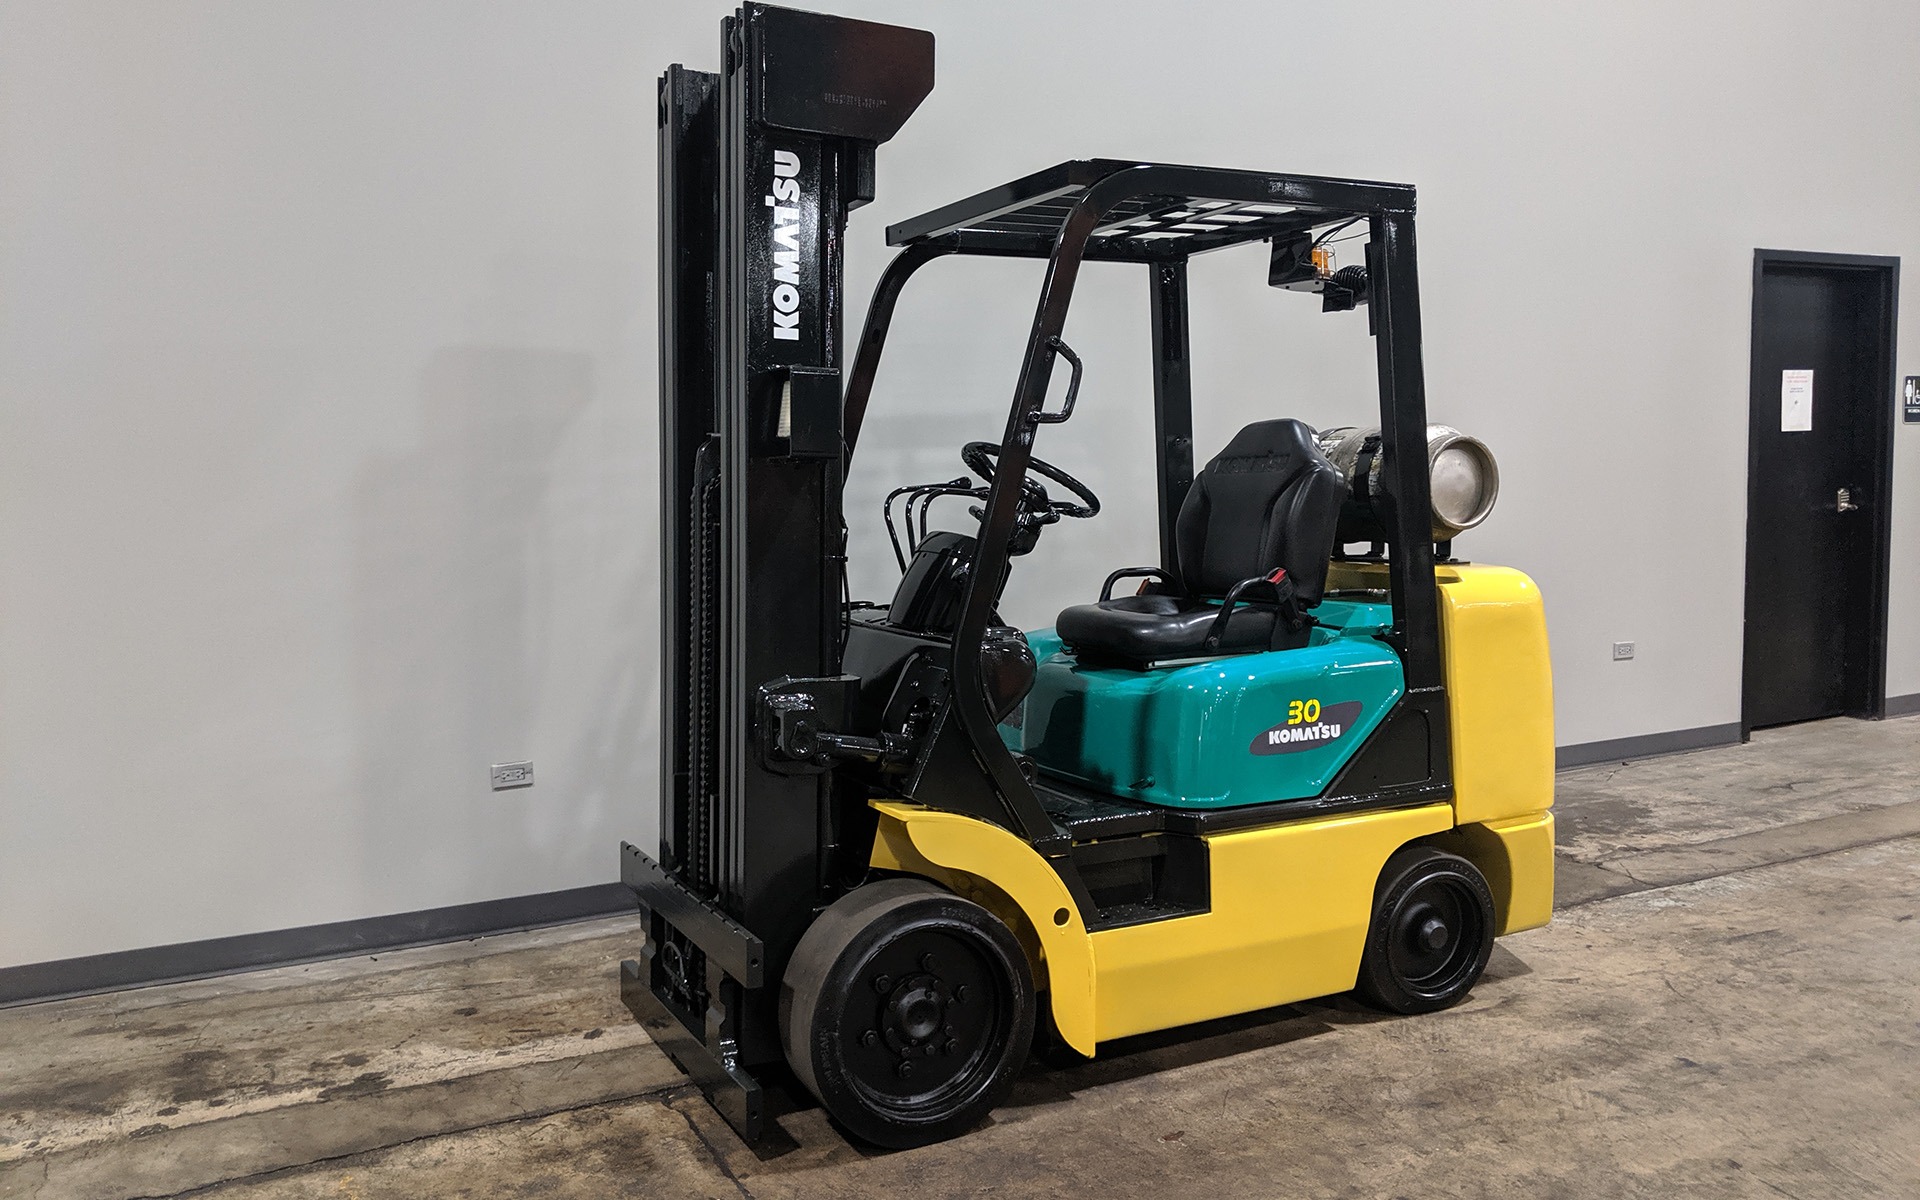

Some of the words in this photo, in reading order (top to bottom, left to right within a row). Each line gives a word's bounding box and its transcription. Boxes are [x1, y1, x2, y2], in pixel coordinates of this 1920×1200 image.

[765, 150, 801, 340] KOMATSU
[1288, 699, 1321, 725] 30
[1269, 722, 1341, 745] KOMATSU
